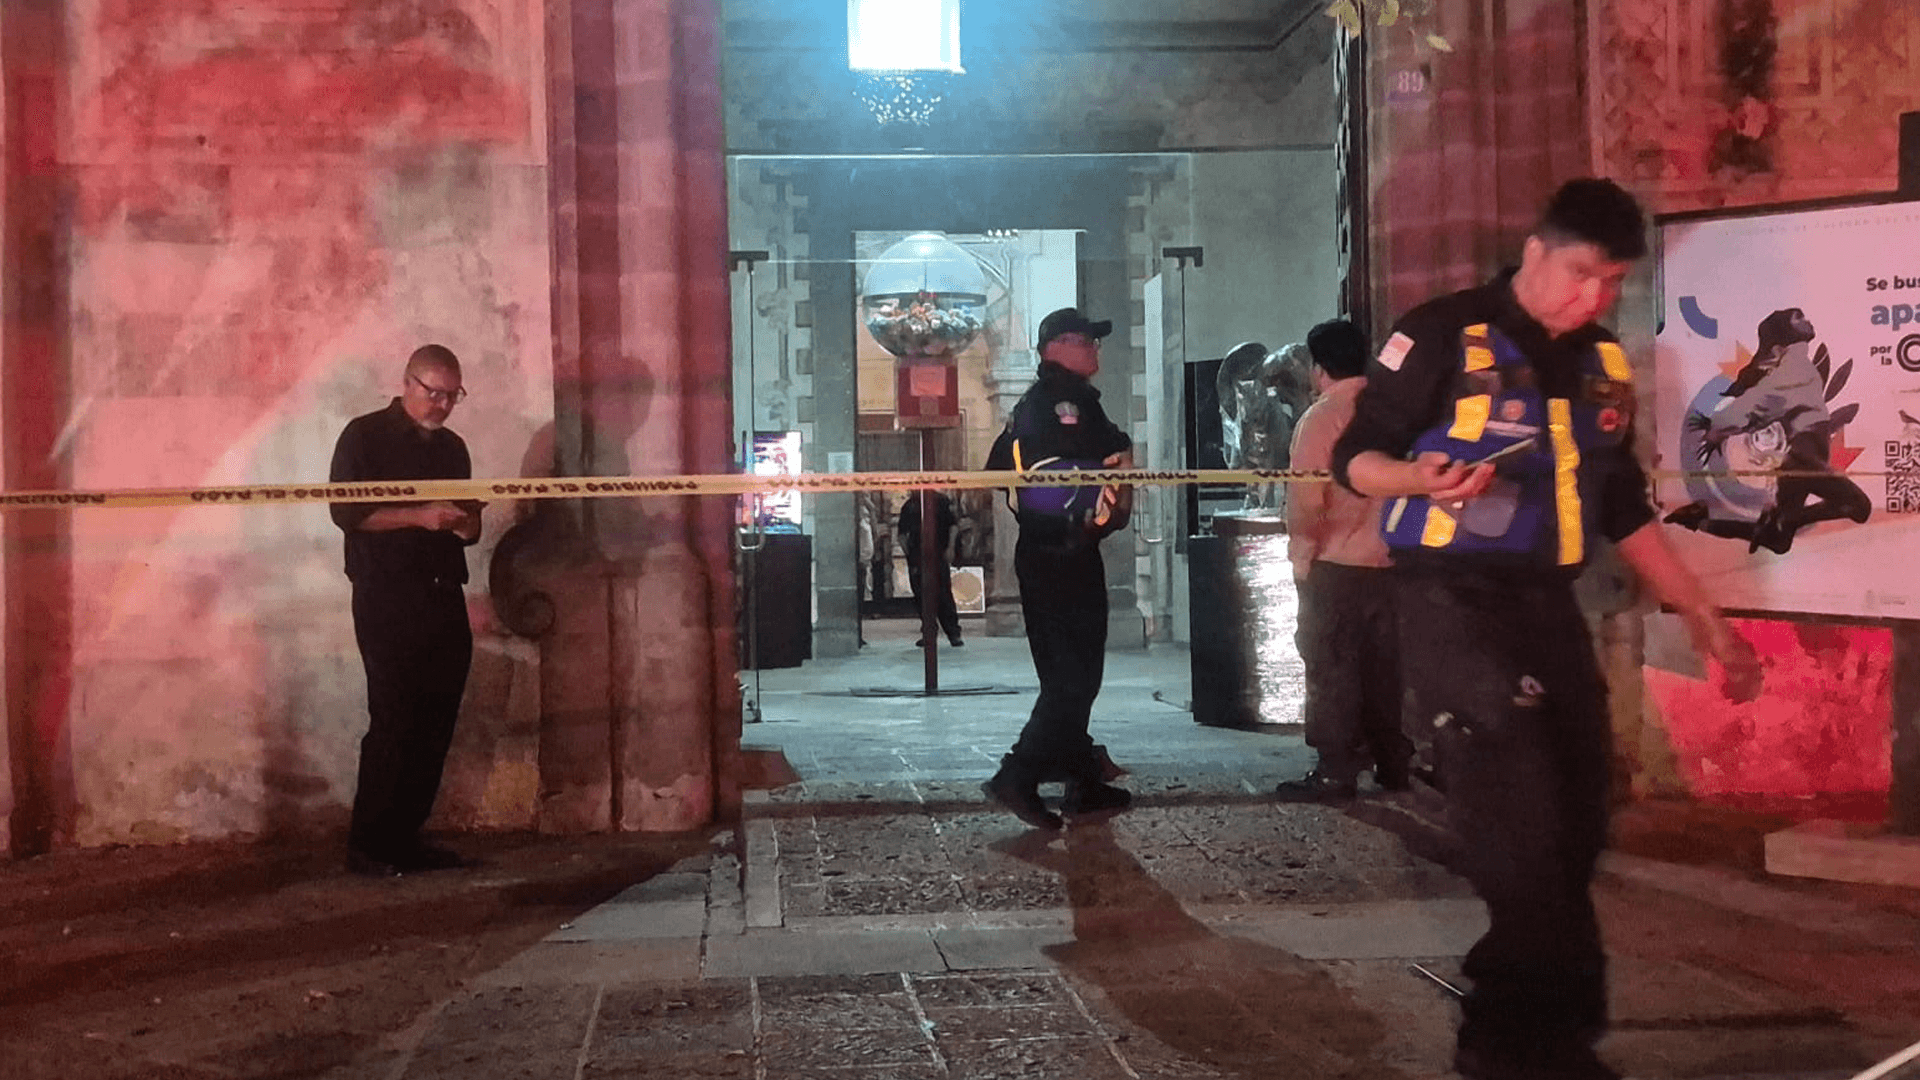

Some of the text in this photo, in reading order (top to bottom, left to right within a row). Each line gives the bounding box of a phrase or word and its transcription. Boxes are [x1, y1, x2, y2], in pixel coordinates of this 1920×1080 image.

[1397, 70, 1424, 93] 89
[1866, 275, 1920, 291] Se bu
[1870, 345, 1892, 357] por
[1881, 356, 1892, 365] la
